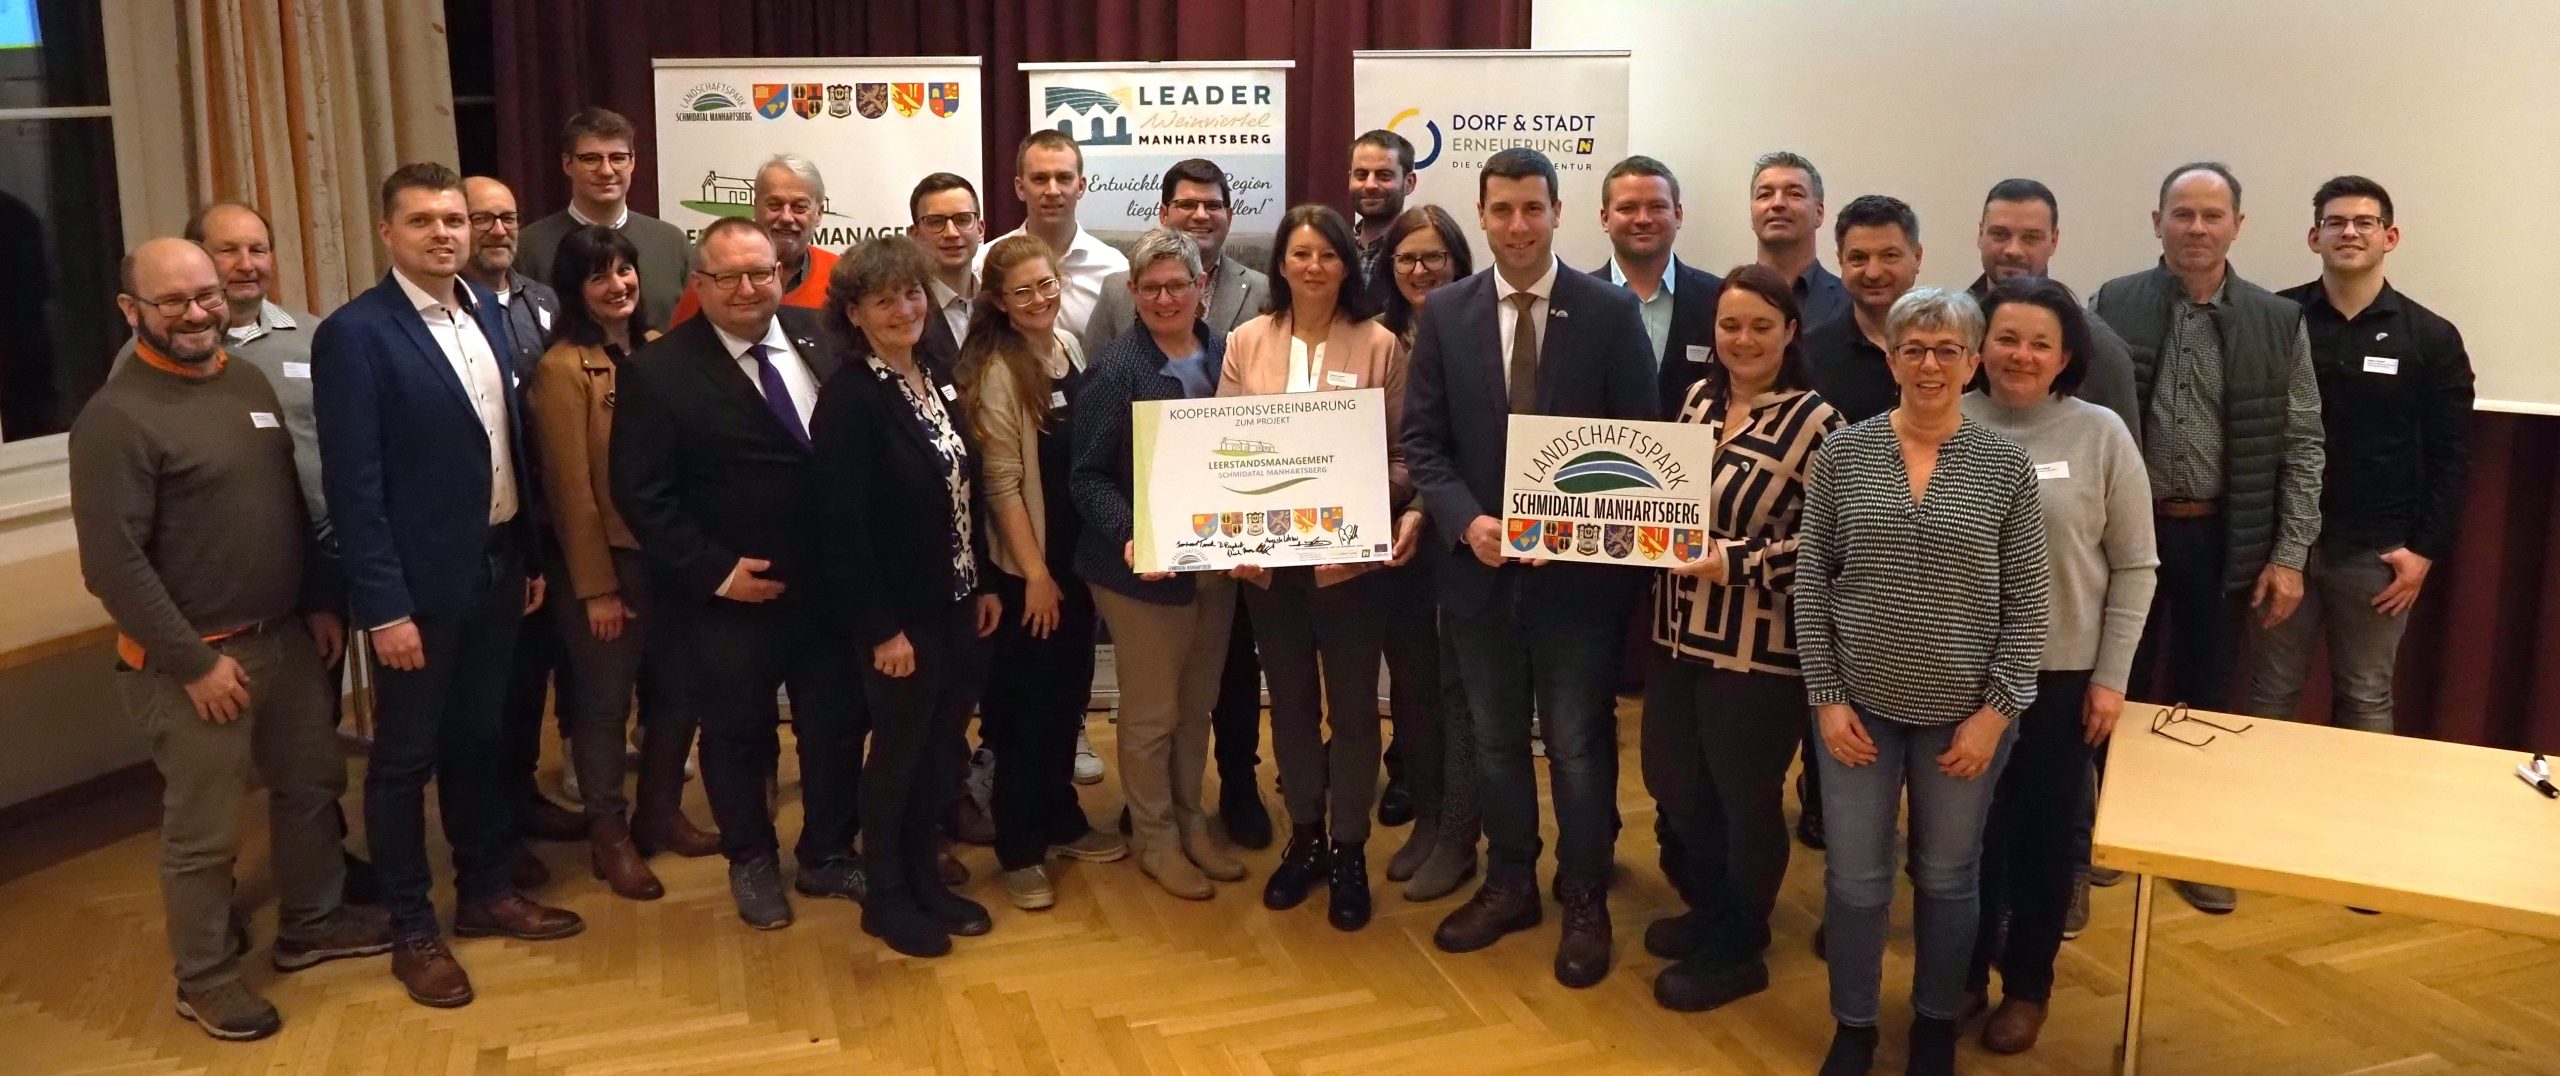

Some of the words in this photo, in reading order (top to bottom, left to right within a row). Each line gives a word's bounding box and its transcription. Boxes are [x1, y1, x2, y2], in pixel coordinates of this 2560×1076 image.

[680, 82, 746, 109] LANDSCHAFTSPARK
[1138, 85, 1271, 106] LEADER
[676, 112, 708, 122] SCHMIDATAL
[709, 111, 753, 121] MANHARTSBERG
[1140, 110, 1271, 129] Weinviertel
[1452, 114, 1508, 131] DORF
[1513, 114, 1526, 131] &
[1532, 115, 1596, 132] STADT
[1138, 134, 1271, 145] MANHARTSBERG
[1452, 138, 1573, 153] ERNEUERUNG
[1452, 161, 1470, 169] DIE
[1088, 173, 1163, 192] Entwicklu
[1126, 199, 1160, 222] liegt
[1170, 399, 1356, 420] KOOPERATIONSVEREINBARUNG
[1235, 418, 1254, 427] ZUM
[1256, 416, 1291, 426] PROJEKT
[1208, 454, 1335, 470] LEERSTANDSMANAGEMENT
[1523, 424, 1689, 491] LANDSCHAFTSPARK
[1218, 469, 1265, 479] SCHMIDATAL
[1266, 467, 1327, 478] MANHARTSBERG
[1511, 493, 1590, 519] SCHMIDATAL
[1594, 498, 1700, 525] MANHARTSBERG
